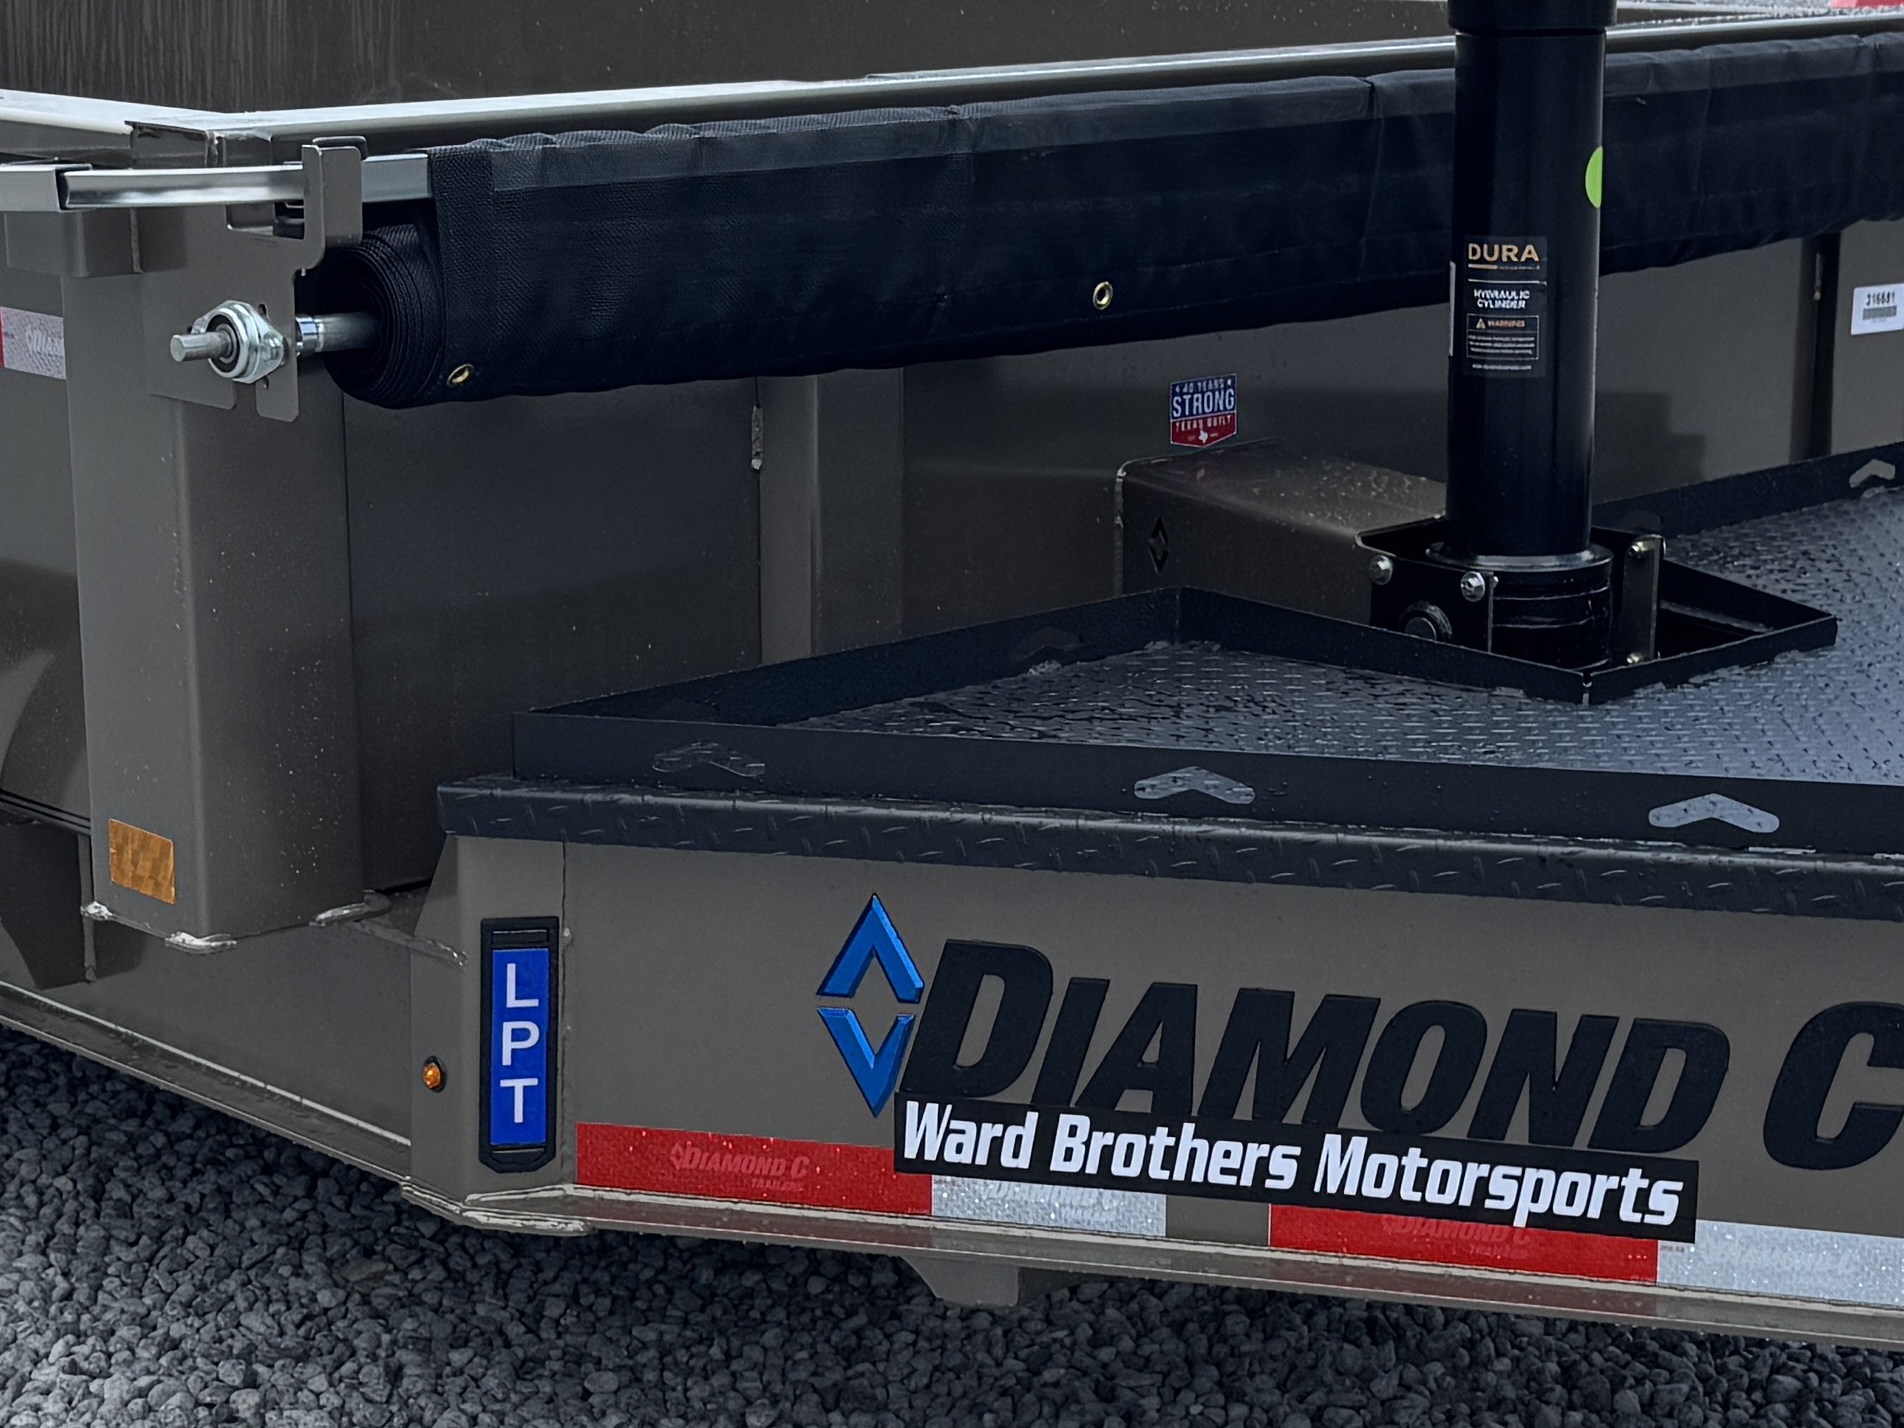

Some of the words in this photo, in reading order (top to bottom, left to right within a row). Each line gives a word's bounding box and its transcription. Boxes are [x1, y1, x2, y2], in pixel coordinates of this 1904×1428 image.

[1468, 243, 1539, 262] DURA
[1473, 289, 1530, 300] HYDRAULIC
[1477, 299, 1526, 309] CYLINDER
[1172, 388, 1235, 418] STRONG
[899, 939, 1730, 1153] DIAMOND
[682, 1144, 788, 1177] DIAMOND
[790, 1155, 811, 1178] C
[904, 1100, 1040, 1170] Ward
[1049, 1113, 1301, 1192] Brothers
[1314, 1133, 1684, 1229] Motorsports
